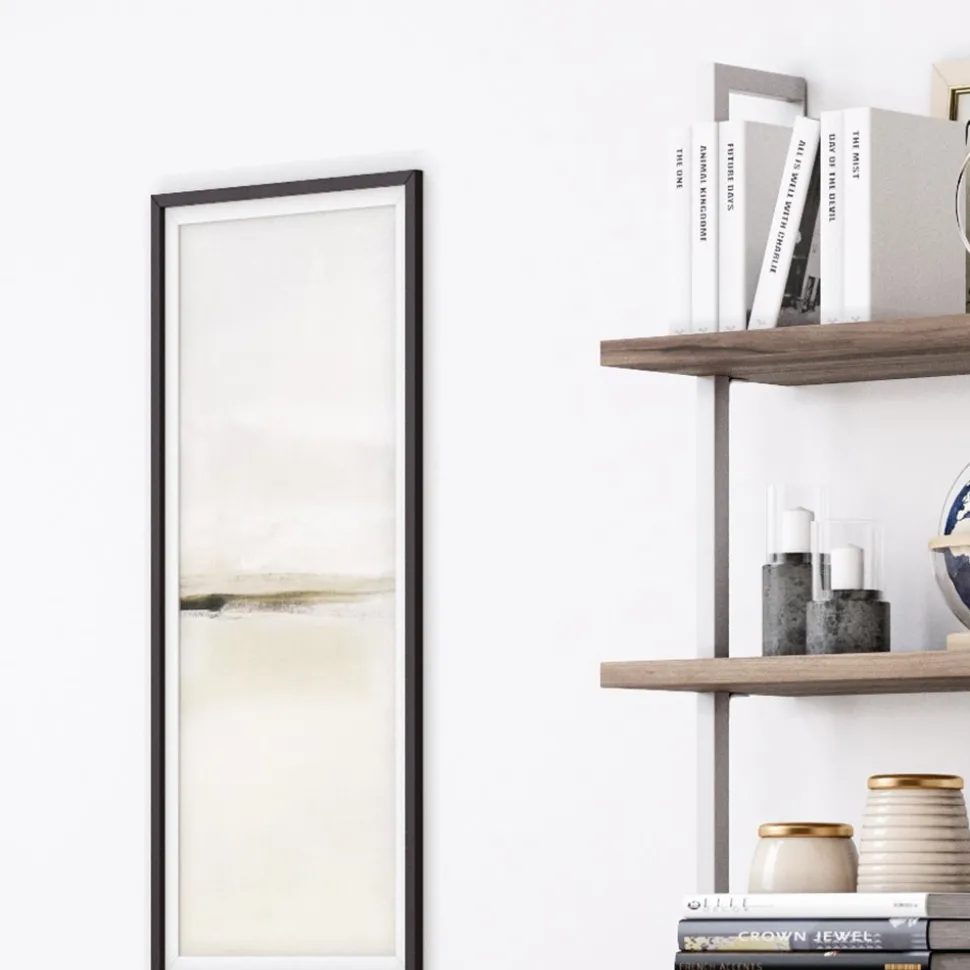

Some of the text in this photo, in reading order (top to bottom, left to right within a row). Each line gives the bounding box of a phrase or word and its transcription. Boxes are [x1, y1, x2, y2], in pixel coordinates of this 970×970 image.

[699, 145, 707, 184] ANIMAL
[852, 130, 860, 179] THE MIST
[828, 133, 836, 222] DAY OF THE DEVIL
[769, 140, 807, 274] ALL IS WELL WITH CHARLIE
[738, 930, 873, 942] CROWN JEWEL
[679, 962, 715, 970] FRENCH
